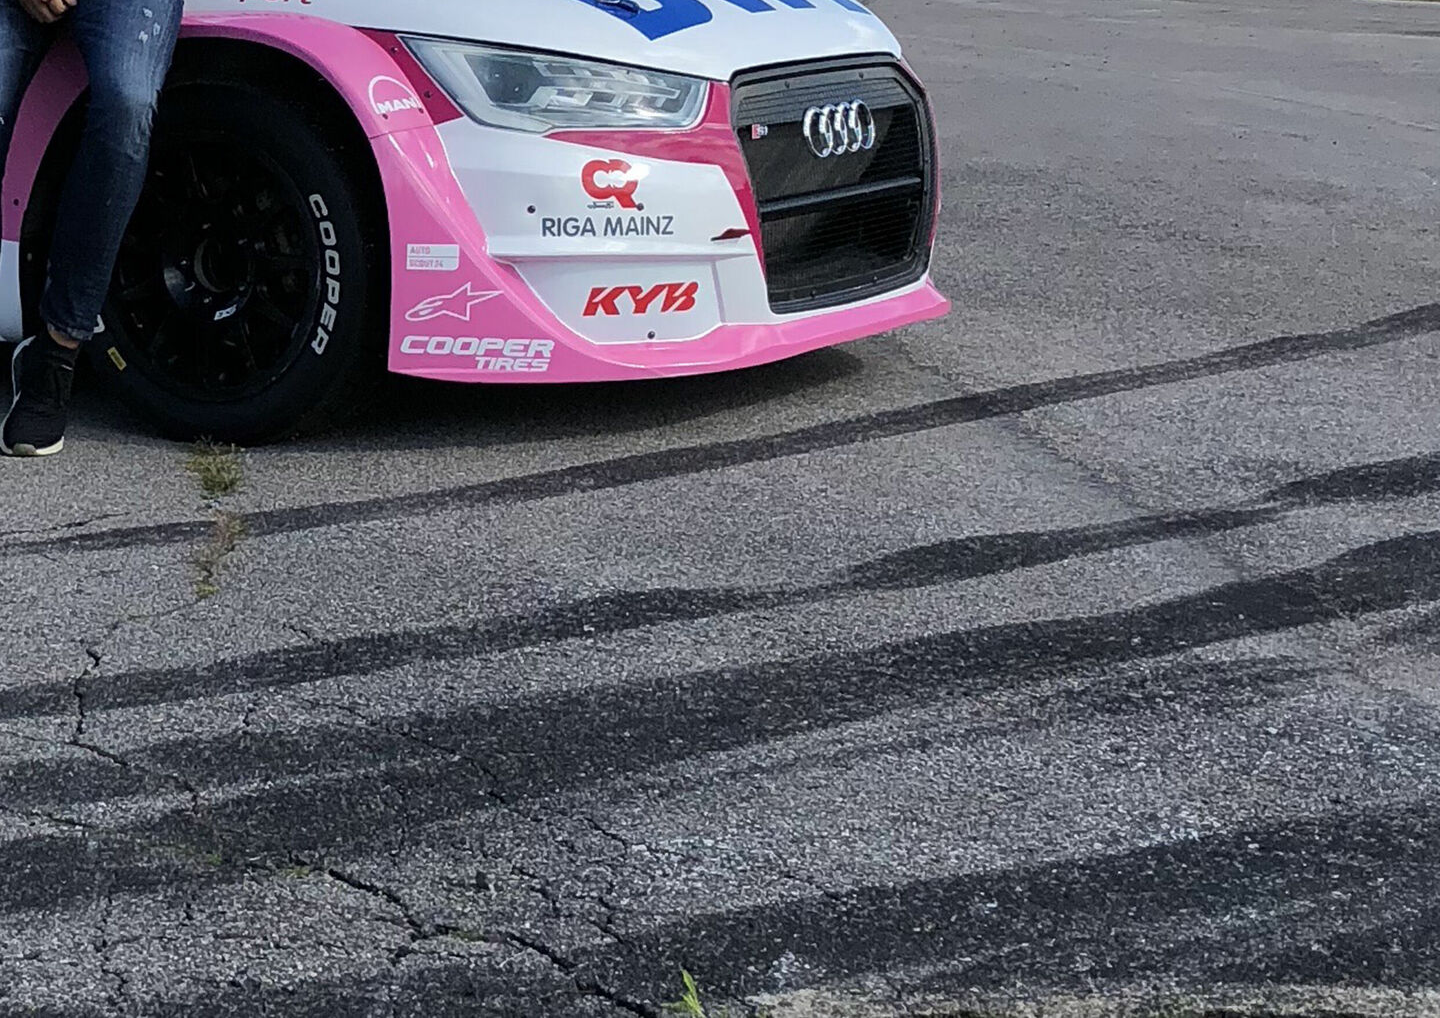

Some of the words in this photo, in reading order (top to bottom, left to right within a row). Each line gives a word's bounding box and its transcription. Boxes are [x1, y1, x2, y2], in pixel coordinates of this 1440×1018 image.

[376, 97, 419, 114] MAN
[542, 217, 596, 237] RIGA
[603, 215, 674, 237] MAINZ
[309, 194, 340, 355] COOPER
[582, 281, 700, 317] KYB
[400, 335, 555, 357] COOPER
[475, 357, 551, 373] TIRES
